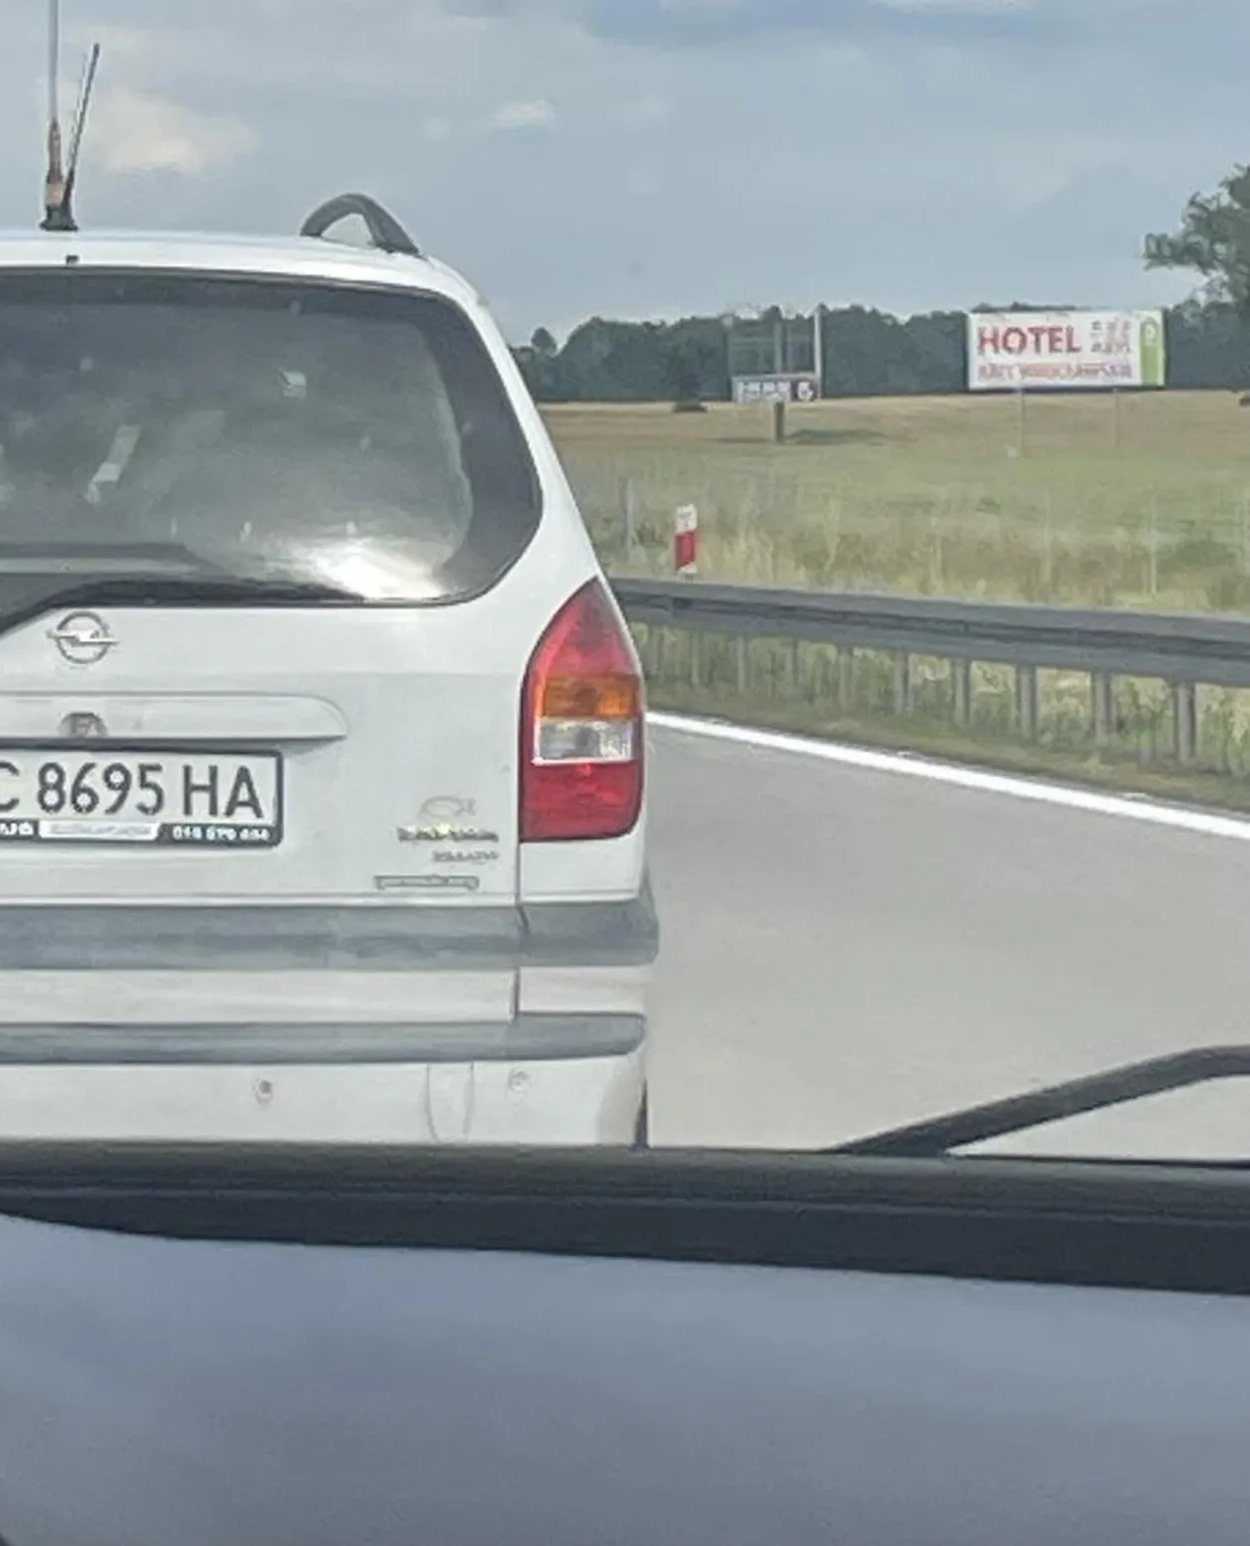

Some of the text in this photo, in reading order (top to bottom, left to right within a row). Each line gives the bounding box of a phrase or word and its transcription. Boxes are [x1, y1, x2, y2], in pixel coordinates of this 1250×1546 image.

[977, 325, 1083, 355] HOTEL
[37, 762, 165, 815] 8695
[183, 765, 264, 818] HA
